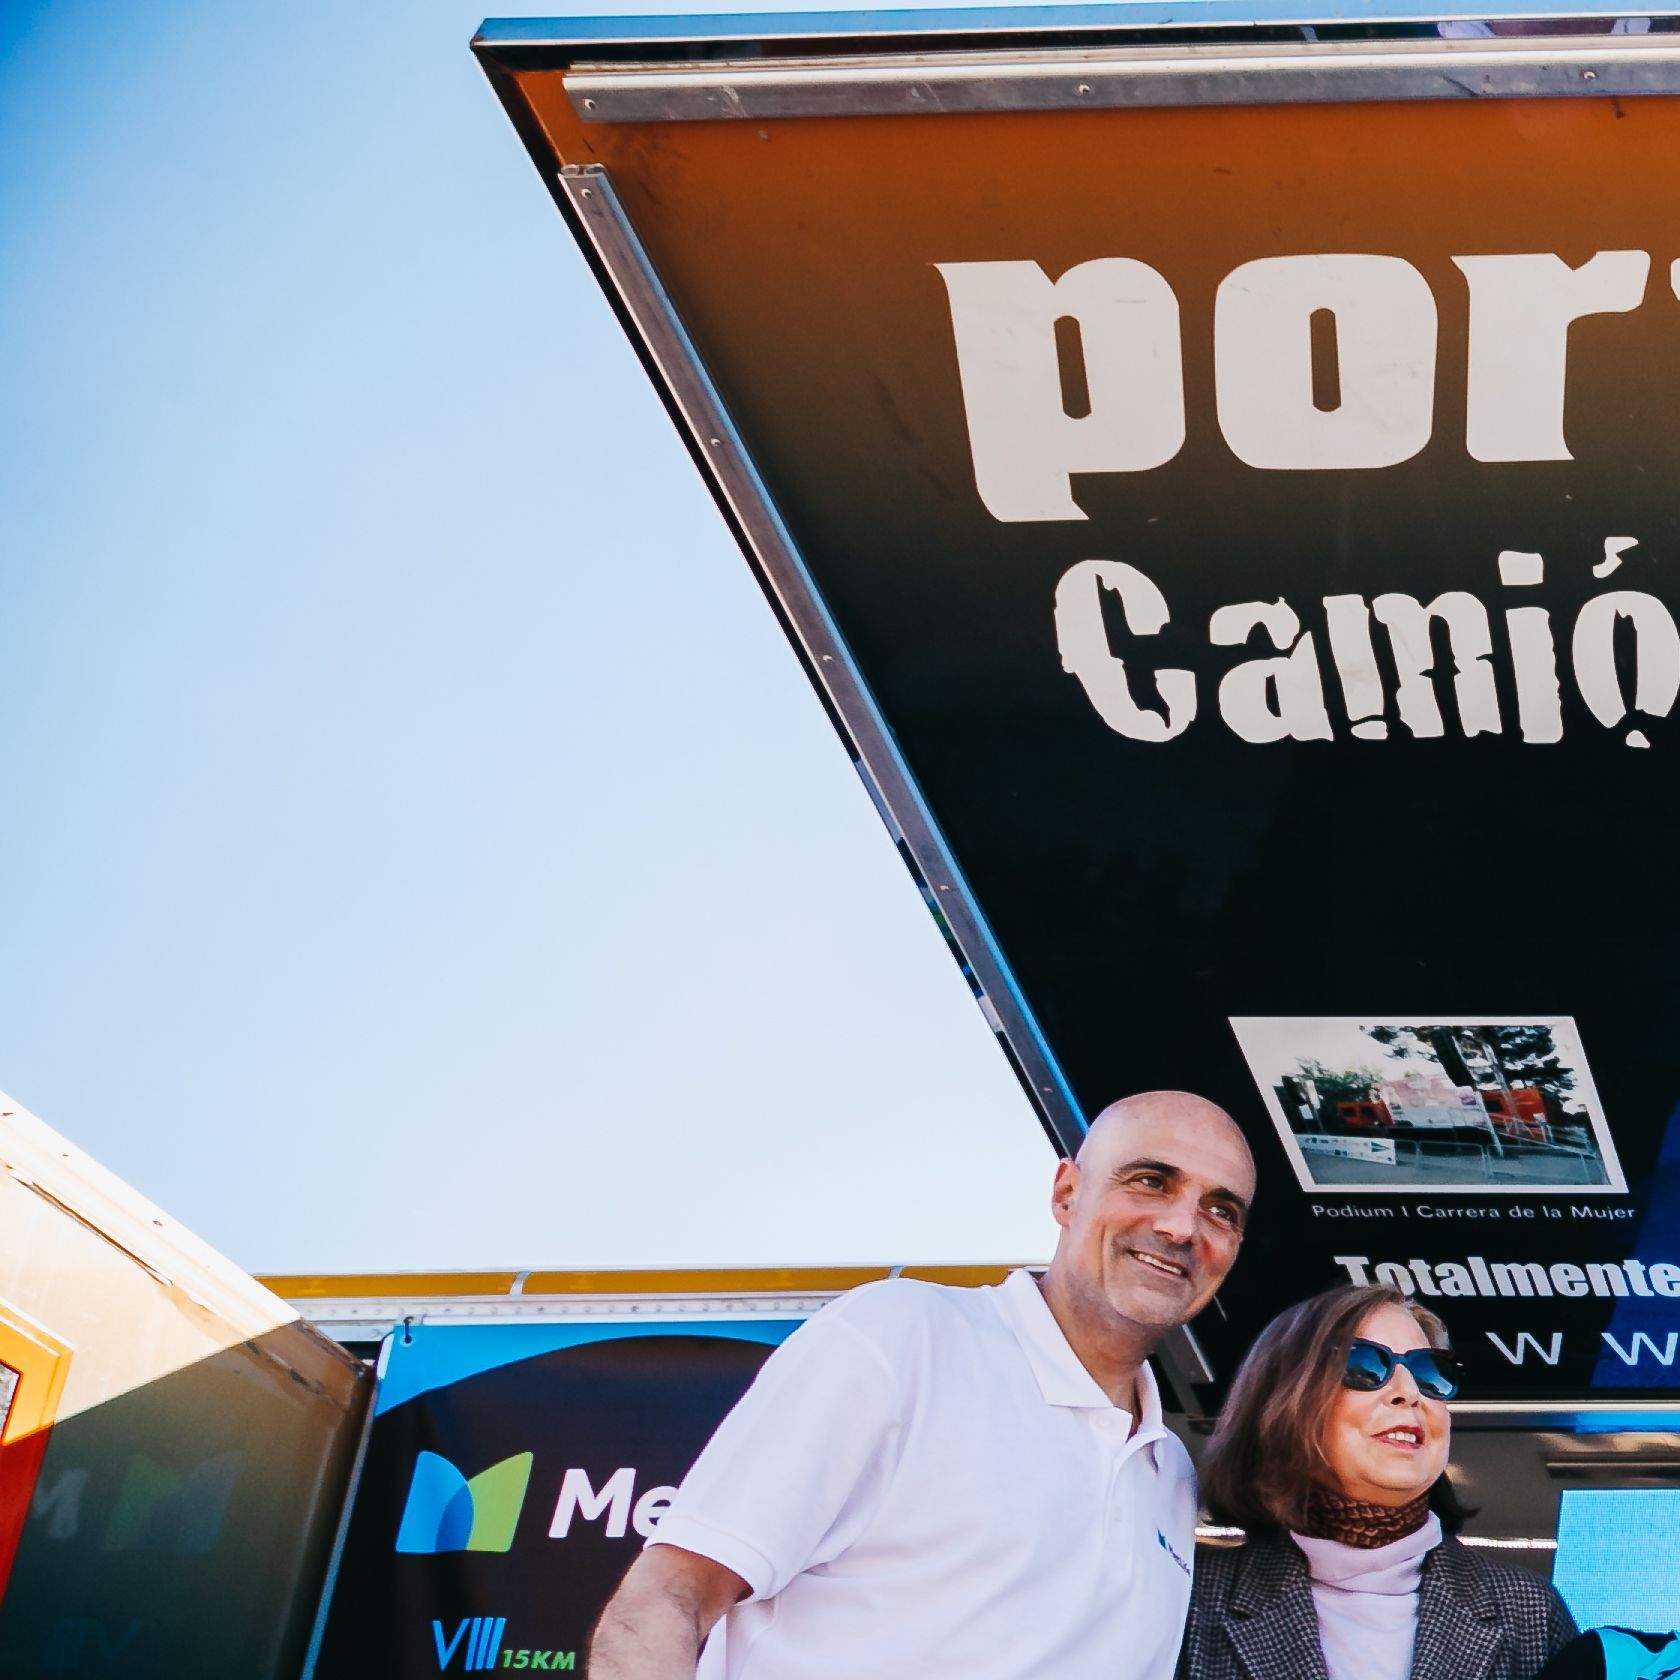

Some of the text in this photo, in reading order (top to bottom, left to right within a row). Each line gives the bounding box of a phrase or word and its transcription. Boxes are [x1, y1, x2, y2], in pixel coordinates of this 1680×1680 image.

[1312, 1205, 1394, 1218] Podium
[1417, 1205, 1500, 1218] Carrera
[1508, 1205, 1535, 1218] de
[1543, 1205, 1562, 1218] la
[1571, 1205, 1635, 1221] Mujer
[432, 1616, 577, 1672] VIII 15KM
